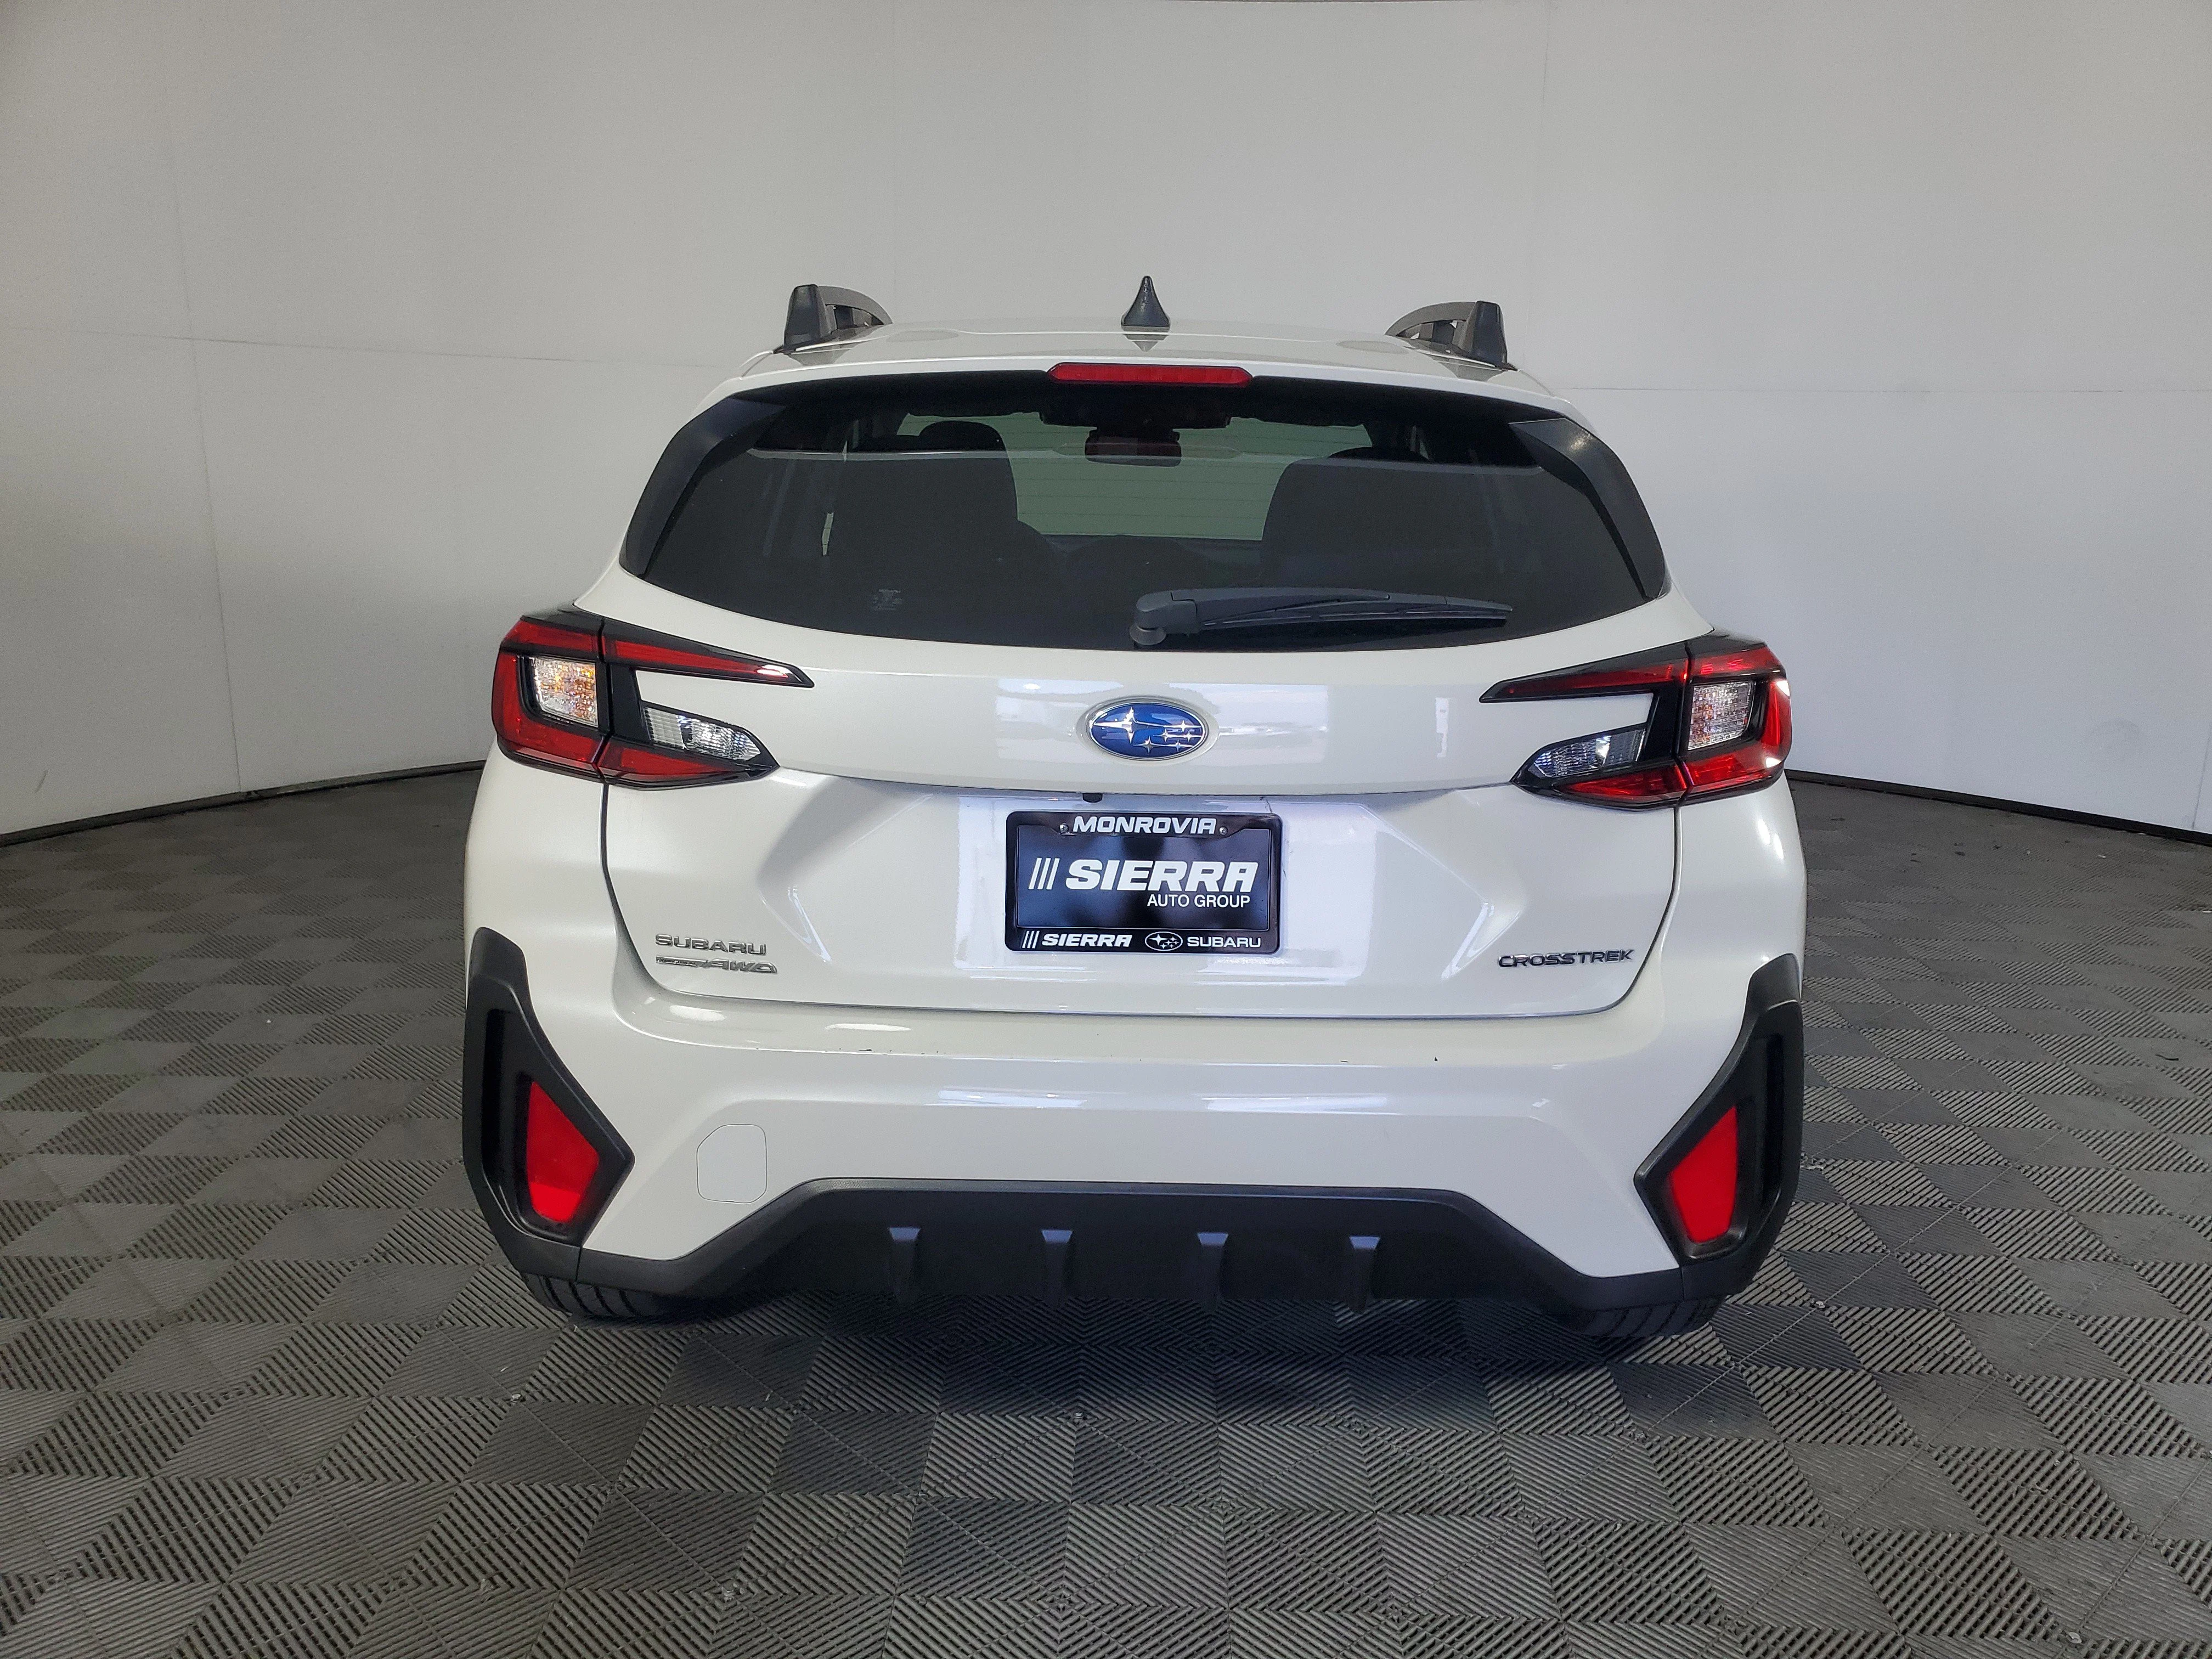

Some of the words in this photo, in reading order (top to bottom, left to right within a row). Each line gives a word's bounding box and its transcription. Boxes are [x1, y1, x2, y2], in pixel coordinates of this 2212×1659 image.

[1073, 816, 1217, 834] MONROVIA
[1065, 859, 1259, 893] SIERRA
[1147, 894, 1190, 907] AUTO
[1194, 894, 1250, 908] GROUP
[655, 934, 766, 955] SUBARU
[1042, 933, 1133, 947] SIERRA
[1187, 936, 1261, 947] SUBARU
[699, 958, 777, 974] AWD
[1498, 949, 1634, 967] CROSSTREK
